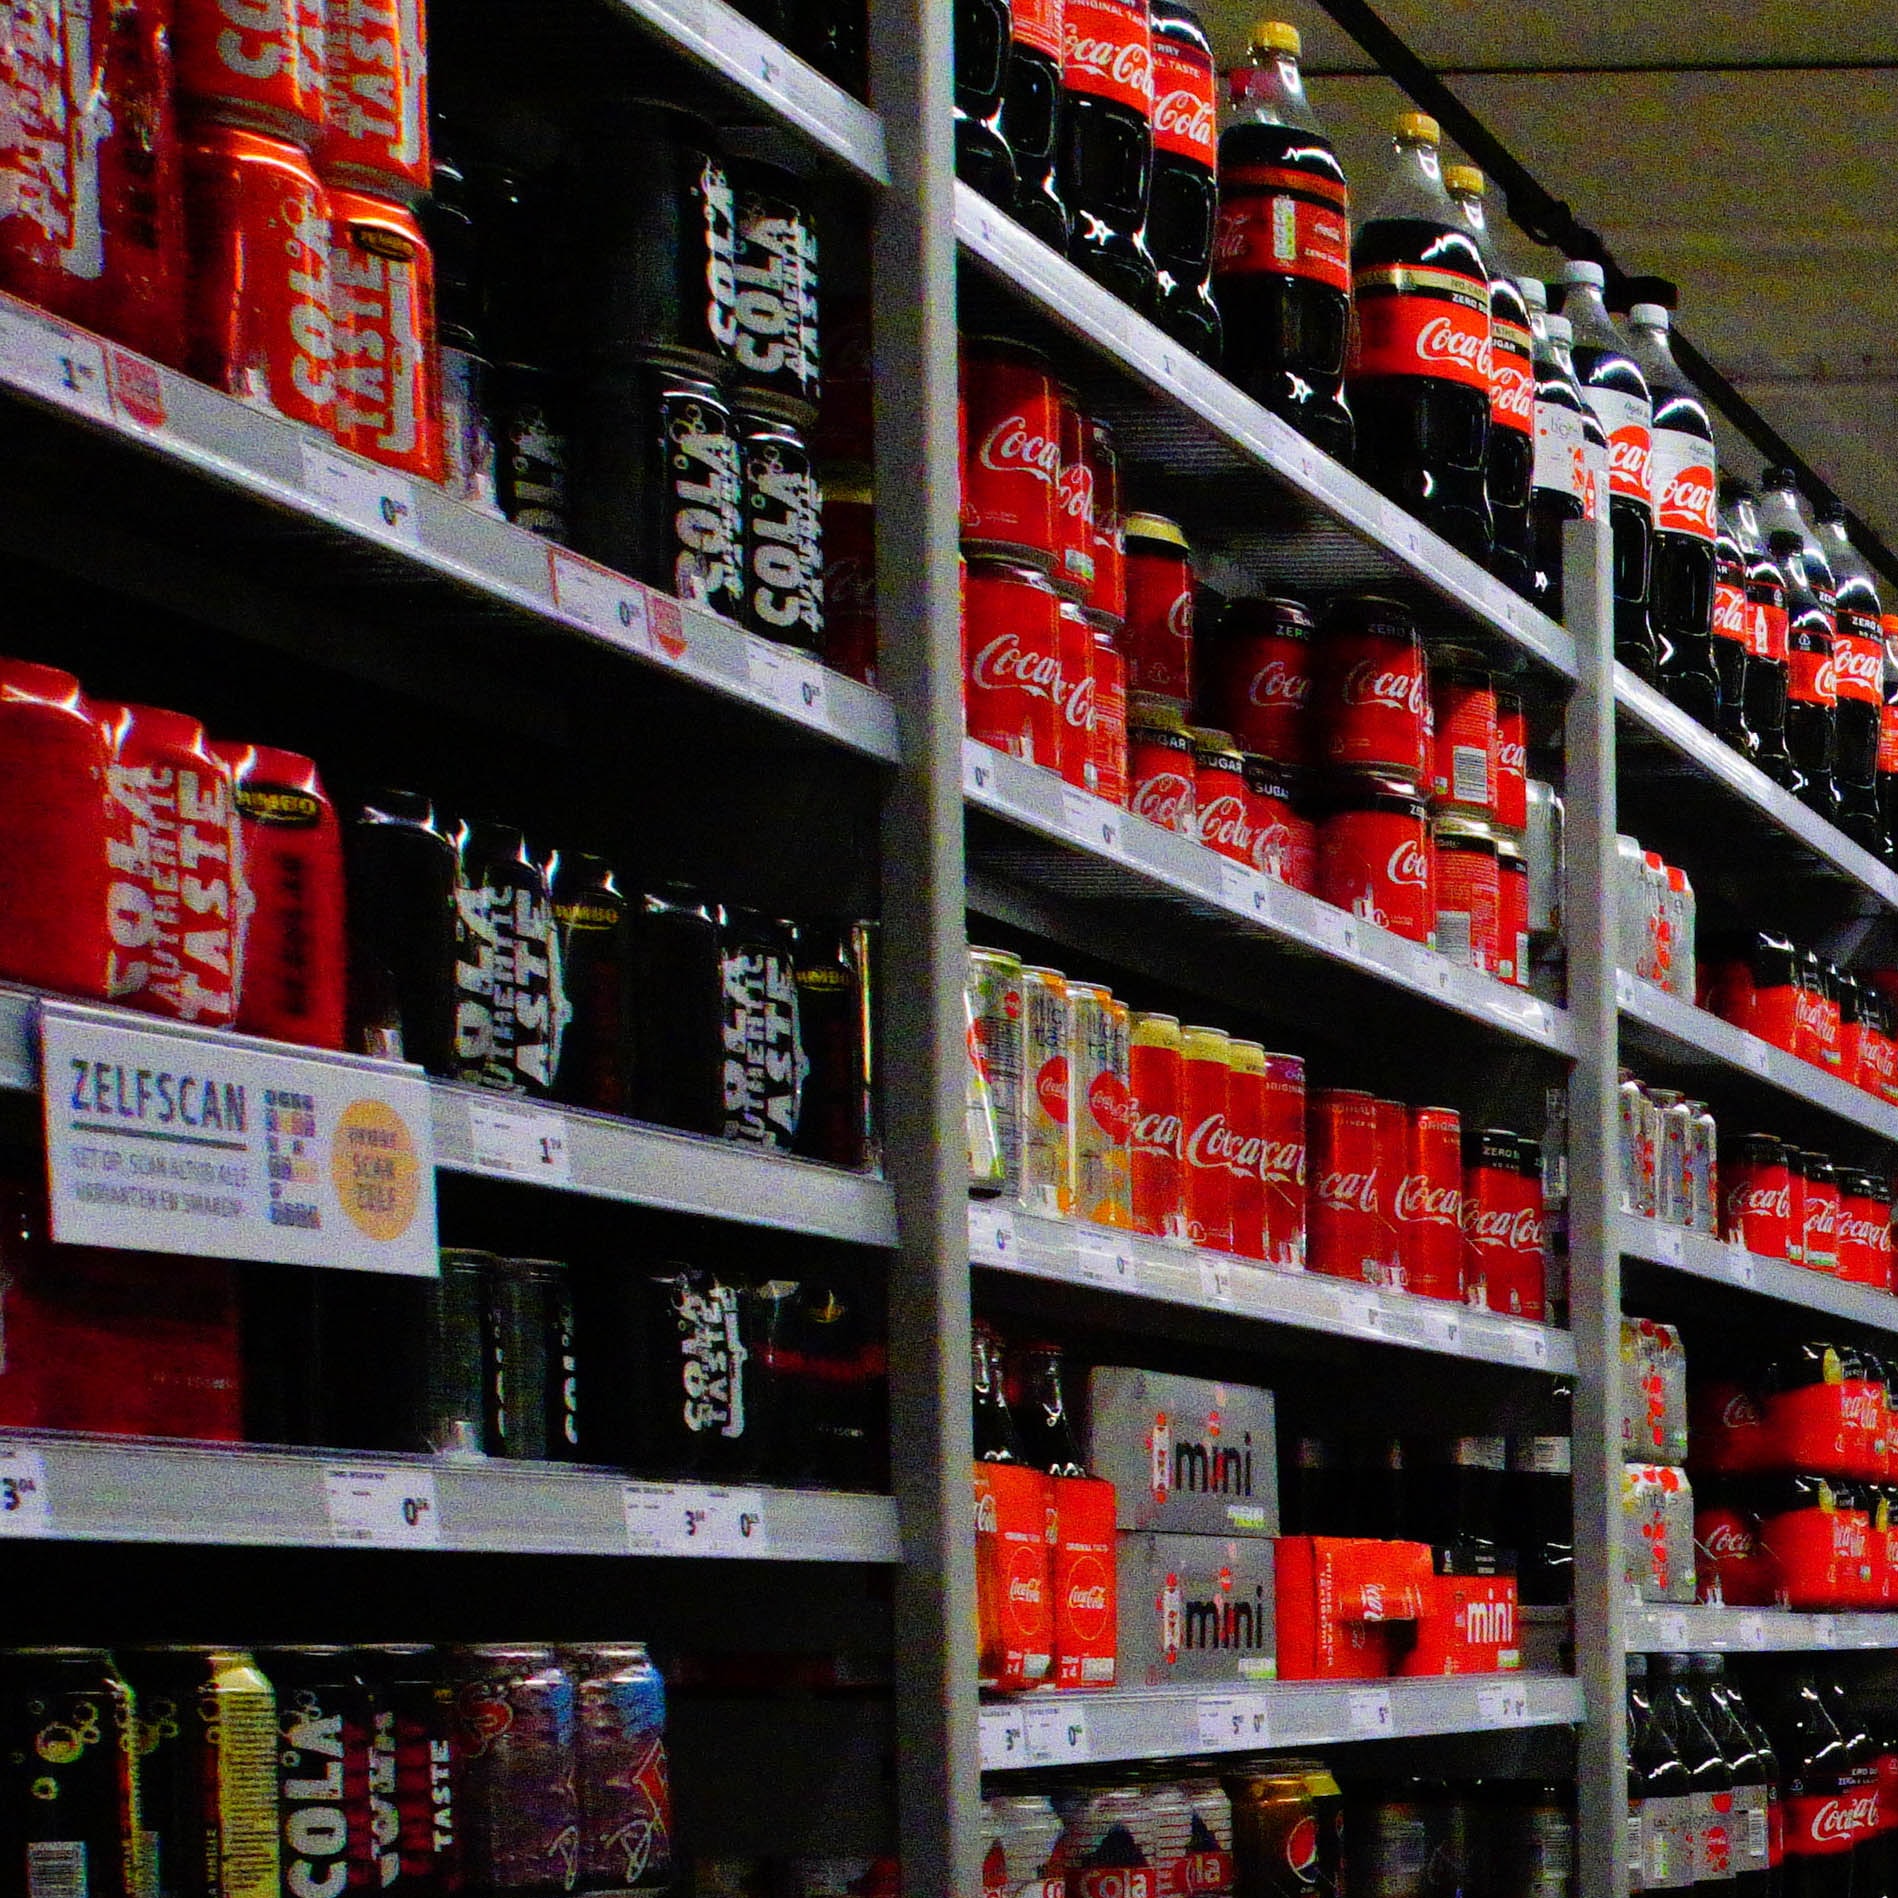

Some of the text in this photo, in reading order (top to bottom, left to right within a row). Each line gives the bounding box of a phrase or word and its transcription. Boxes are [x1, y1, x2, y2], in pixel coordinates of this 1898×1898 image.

[289, 197, 334, 406] COLA
[733, 215, 800, 373] COLA
[1417, 316, 1494, 382] Coca-C
[752, 472, 806, 629] COLA
[177, 770, 232, 1021] TASTE
[514, 888, 550, 1088] ASTE
[69, 1058, 247, 1134] ZELFSCAN
[1175, 1433, 1253, 1496] mini
[1185, 1585, 1264, 1651] mini
[1466, 1591, 1515, 1644] mini
[430, 1740, 454, 1853] TASTE
